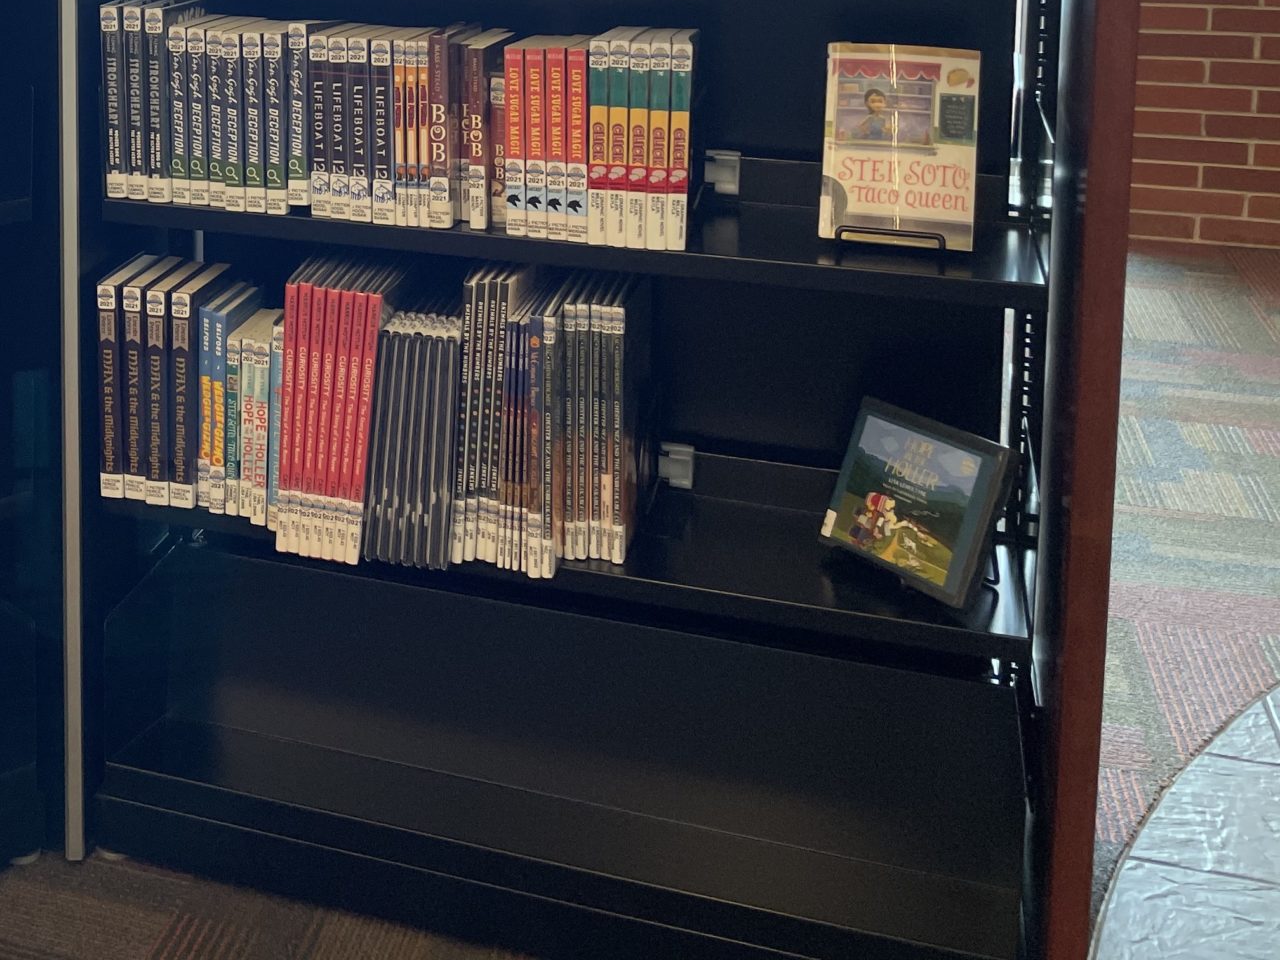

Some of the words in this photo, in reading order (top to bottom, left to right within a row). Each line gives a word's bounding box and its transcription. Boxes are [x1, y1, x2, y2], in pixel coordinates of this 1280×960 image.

[107, 58, 119, 126] STRONGHEART
[129, 58, 140, 127] STRONGHEART
[149, 60, 160, 129] STRONGHEART
[510, 68, 519, 92] LOVE
[530, 69, 541, 93] LOVE
[551, 68, 561, 92] LOVE
[173, 100, 184, 156] DECEPTION
[191, 102, 202, 158] DECEPTION
[291, 100, 302, 157] DECEPTION
[314, 82, 323, 150] LIFEBOAT
[332, 83, 342, 152] LIFEBOAT
[354, 86, 363, 155] LIFEBOAT
[375, 87, 385, 157] LIFEBOAT
[510, 95, 519, 123] SUGAR
[530, 95, 541, 123] SUGAR
[551, 95, 561, 123] SUGAR
[211, 104, 221, 160] DECEPTION
[227, 108, 237, 164] DECEPTION
[248, 108, 258, 164] DECEPTION
[269, 108, 279, 165] DECEPTION
[431, 104, 446, 162] BOB
[470, 115, 483, 157] BOB
[510, 125, 519, 156] MAGIC
[530, 126, 541, 157] MAGIC
[551, 126, 561, 157] MAGIC
[592, 122, 605, 163] CLICK
[612, 123, 625, 164] CLICK
[632, 124, 645, 166] CLICK
[653, 127, 666, 168] CLICK
[673, 128, 686, 168] CLICK
[494, 144, 504, 179] BOB
[298, 347, 306, 390] CURIOSITY
[324, 353, 332, 396] CURIOSITY
[350, 357, 358, 400] CURIOSITY
[363, 358, 373, 402] CURIOSITY
[105, 395, 113, 414] the
[176, 403, 186, 422] the
[243, 395, 254, 427] HOPE
[256, 402, 266, 432] HOPE
[253, 444, 266, 489] HOLLER
